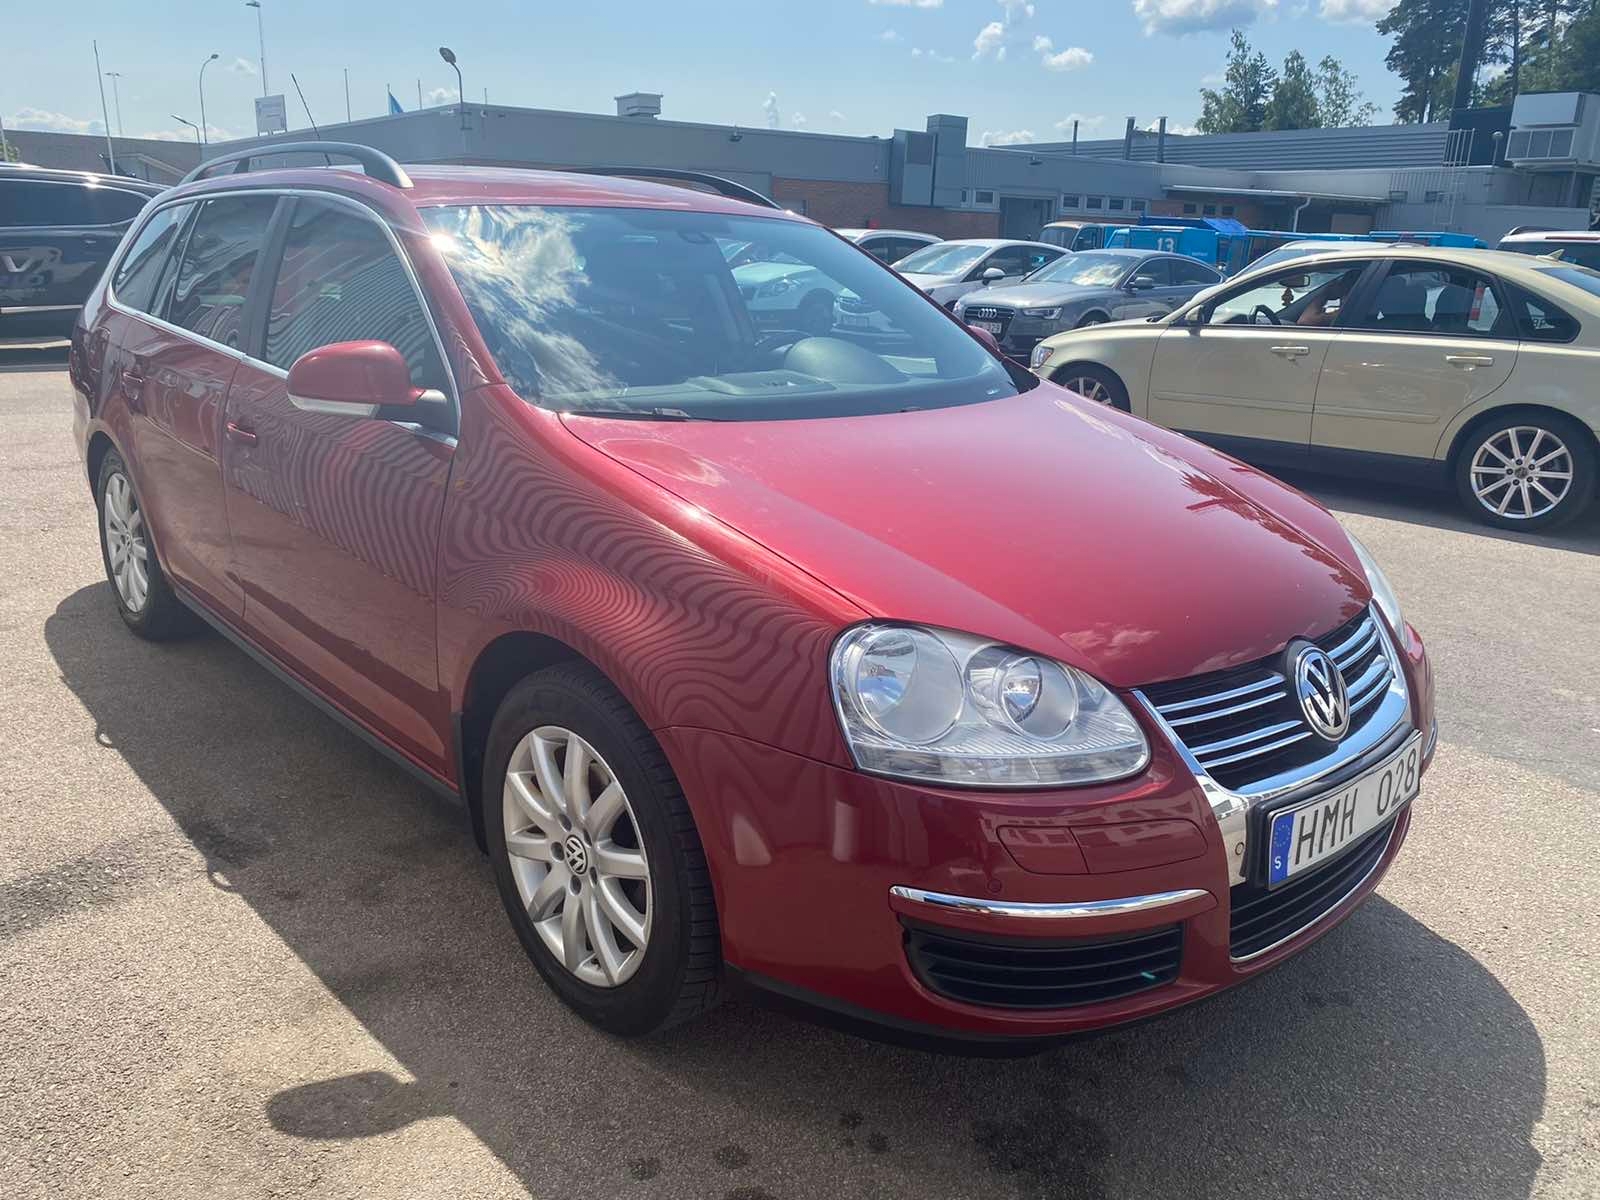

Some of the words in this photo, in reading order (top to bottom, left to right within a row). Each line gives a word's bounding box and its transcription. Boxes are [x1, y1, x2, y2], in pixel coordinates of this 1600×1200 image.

[1157, 237, 1174, 253] 13
[1294, 788, 1358, 865] HMH
[1376, 748, 1416, 816] 028
[1274, 855, 1282, 870] S
